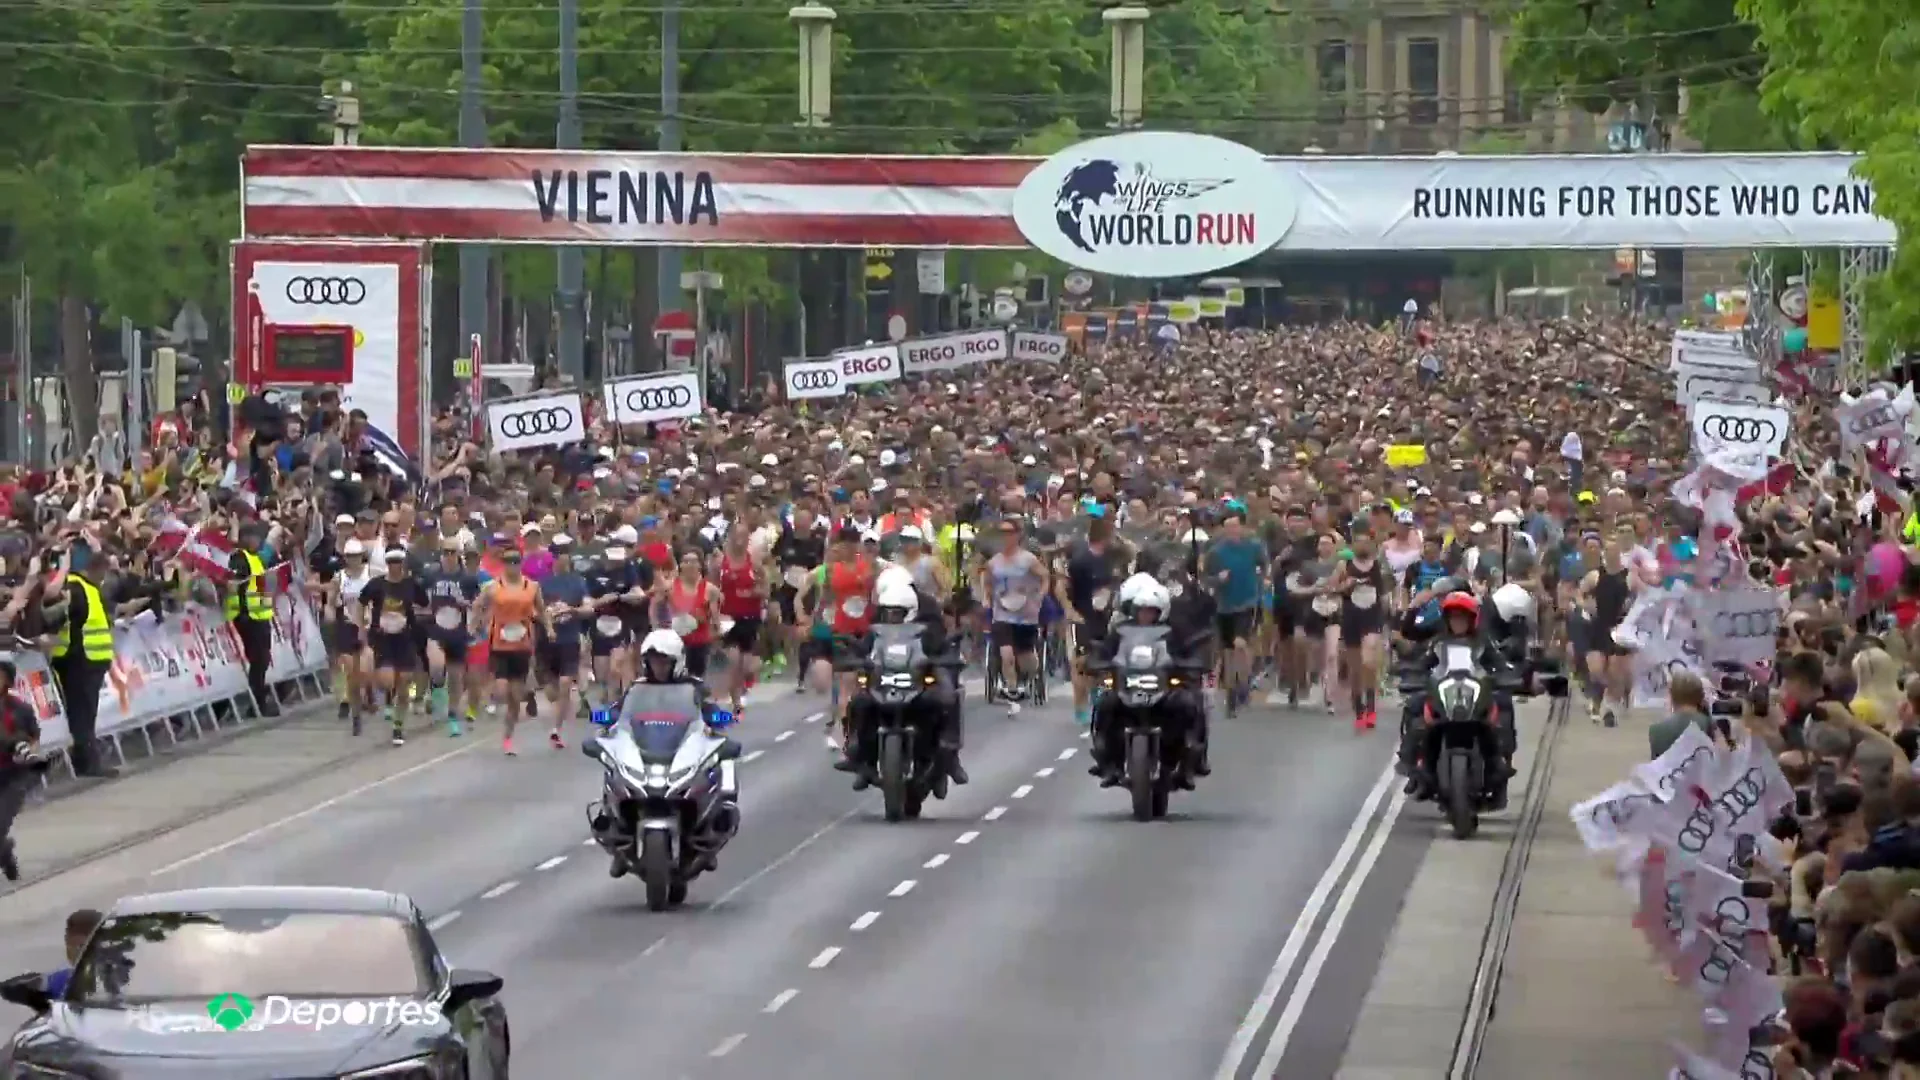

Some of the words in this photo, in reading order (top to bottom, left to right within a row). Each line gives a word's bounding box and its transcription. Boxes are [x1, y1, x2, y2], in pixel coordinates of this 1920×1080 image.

[531, 169, 719, 226] VIENNA
[1118, 181, 1188, 197] WINGS
[1126, 197, 1169, 213] LIFE
[1413, 187, 1546, 219] RUNNING
[1558, 186, 1616, 217] FOR
[1626, 185, 1721, 217] THOSE
[1731, 184, 1800, 216] WHO
[1812, 184, 1871, 215] CAN
[908, 345, 956, 364] ERGO
[842, 356, 892, 377] ERGO
